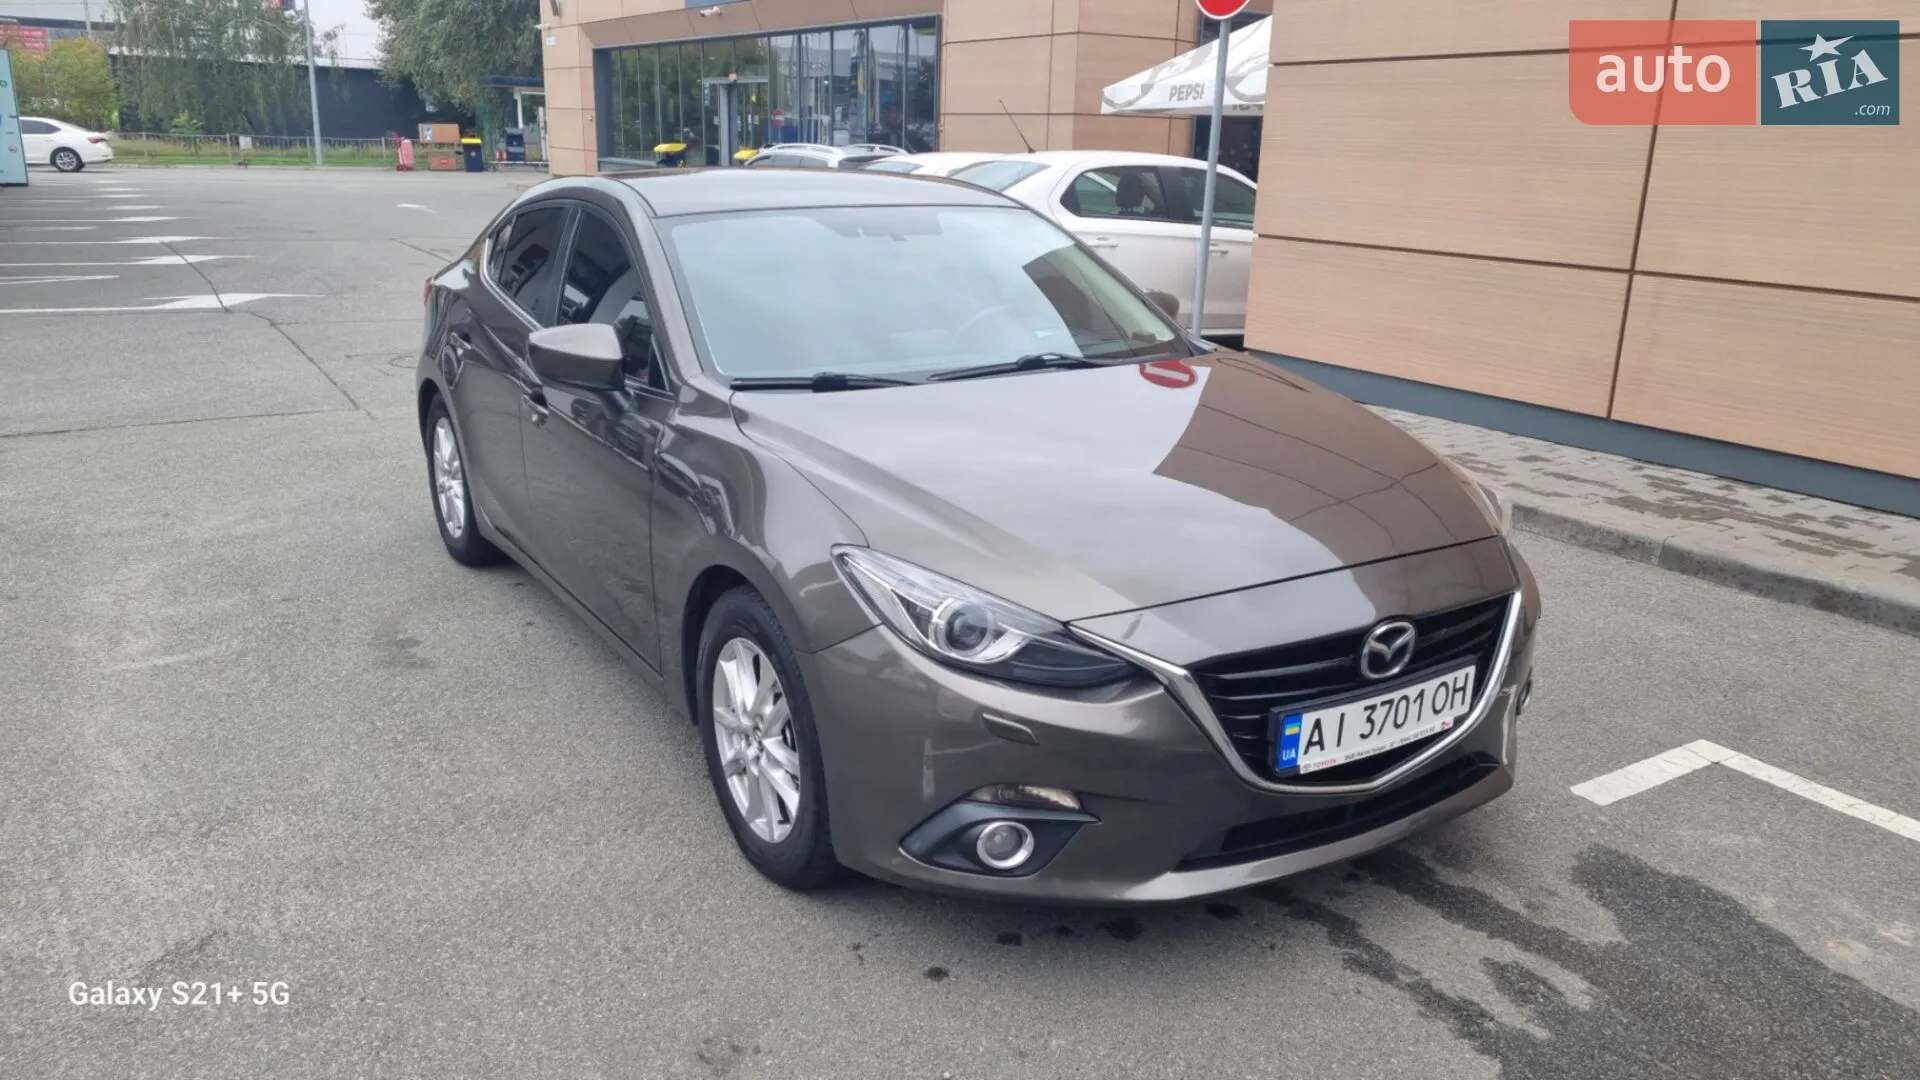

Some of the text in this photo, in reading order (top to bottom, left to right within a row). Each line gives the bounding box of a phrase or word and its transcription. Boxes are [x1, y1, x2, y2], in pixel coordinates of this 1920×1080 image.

[1168, 82, 1205, 102] PEPSI
[1303, 712, 1346, 756] AI
[1359, 688, 1425, 739] 3701
[1432, 672, 1469, 715] OH
[1282, 749, 1297, 761] UA
